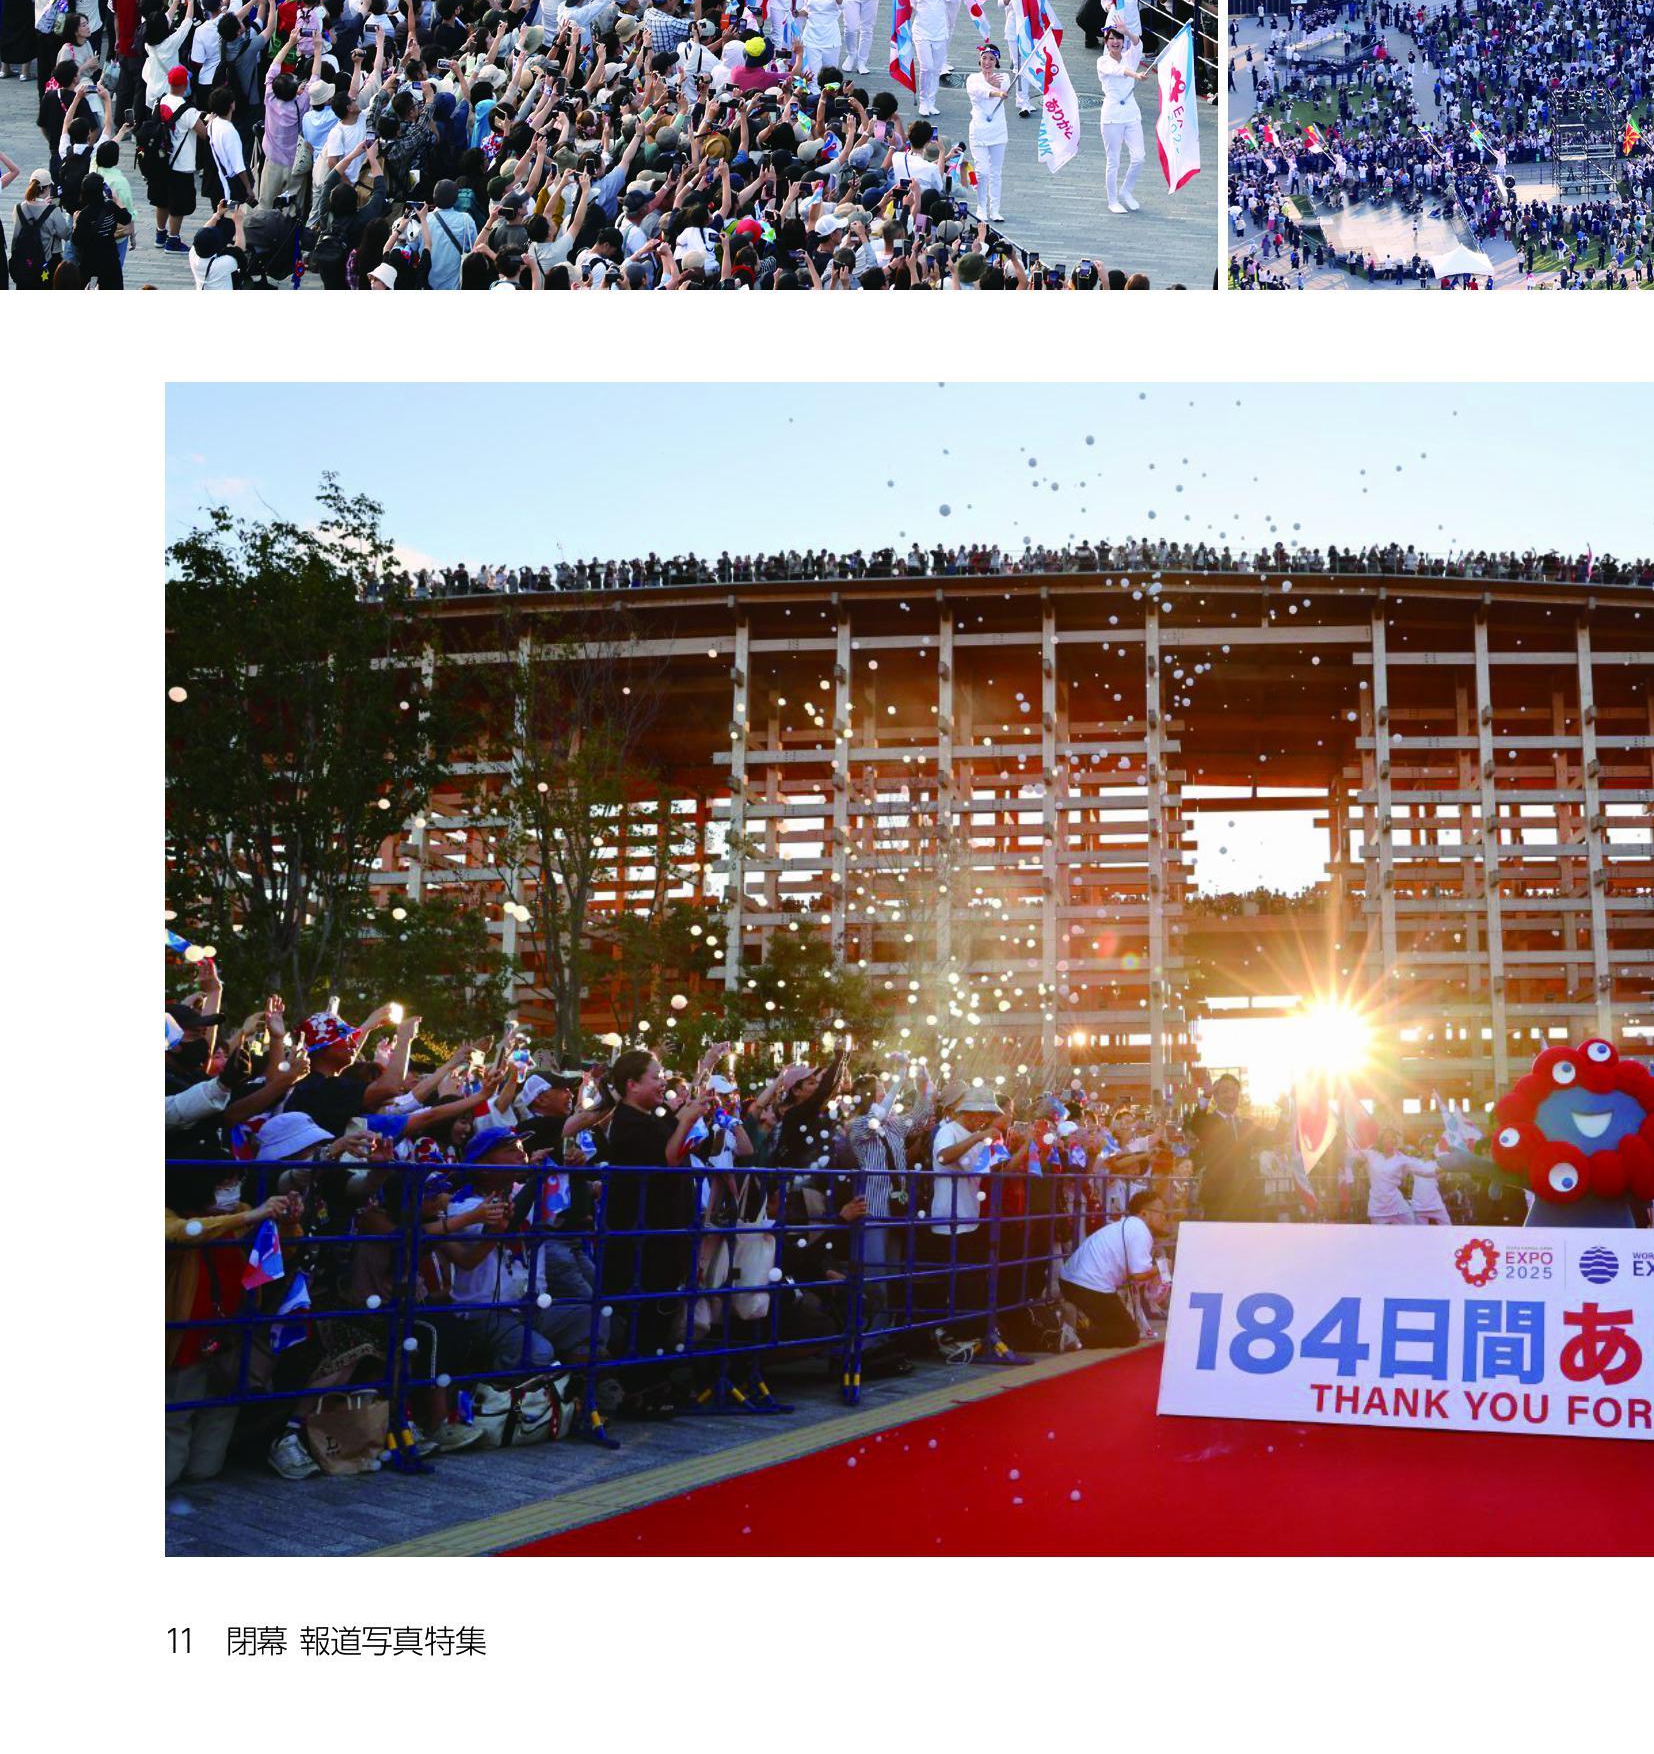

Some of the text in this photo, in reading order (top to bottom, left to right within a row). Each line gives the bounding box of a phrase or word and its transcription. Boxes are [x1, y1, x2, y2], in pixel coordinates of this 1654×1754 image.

[1505, 1251, 1553, 1265] EXPO
[1505, 1266, 1552, 1280] 2025
[1309, 1383, 1449, 1421] THANK
[1465, 1390, 1550, 1426] YOU
[1567, 1395, 1652, 1432] FOR
